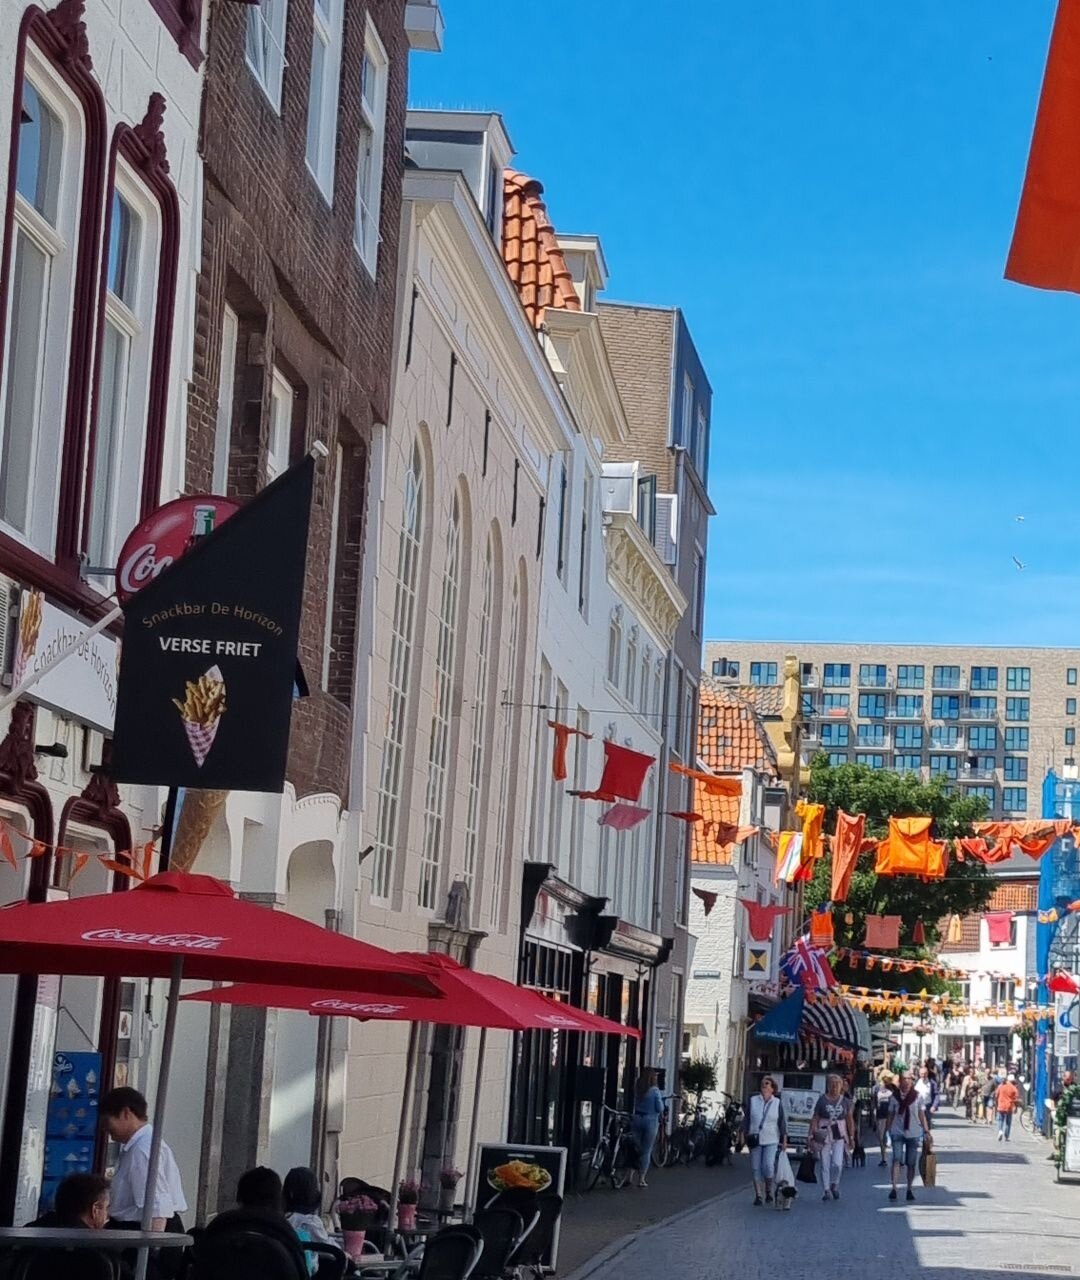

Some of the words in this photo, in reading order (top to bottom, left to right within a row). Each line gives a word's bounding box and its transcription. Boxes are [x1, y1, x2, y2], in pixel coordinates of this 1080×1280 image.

[142, 602, 207, 629] Snackbar
[211, 602, 230, 615] De
[234, 606, 284, 637] Horizon
[159, 636, 212, 654] VERSE
[215, 641, 262, 658] FRIET
